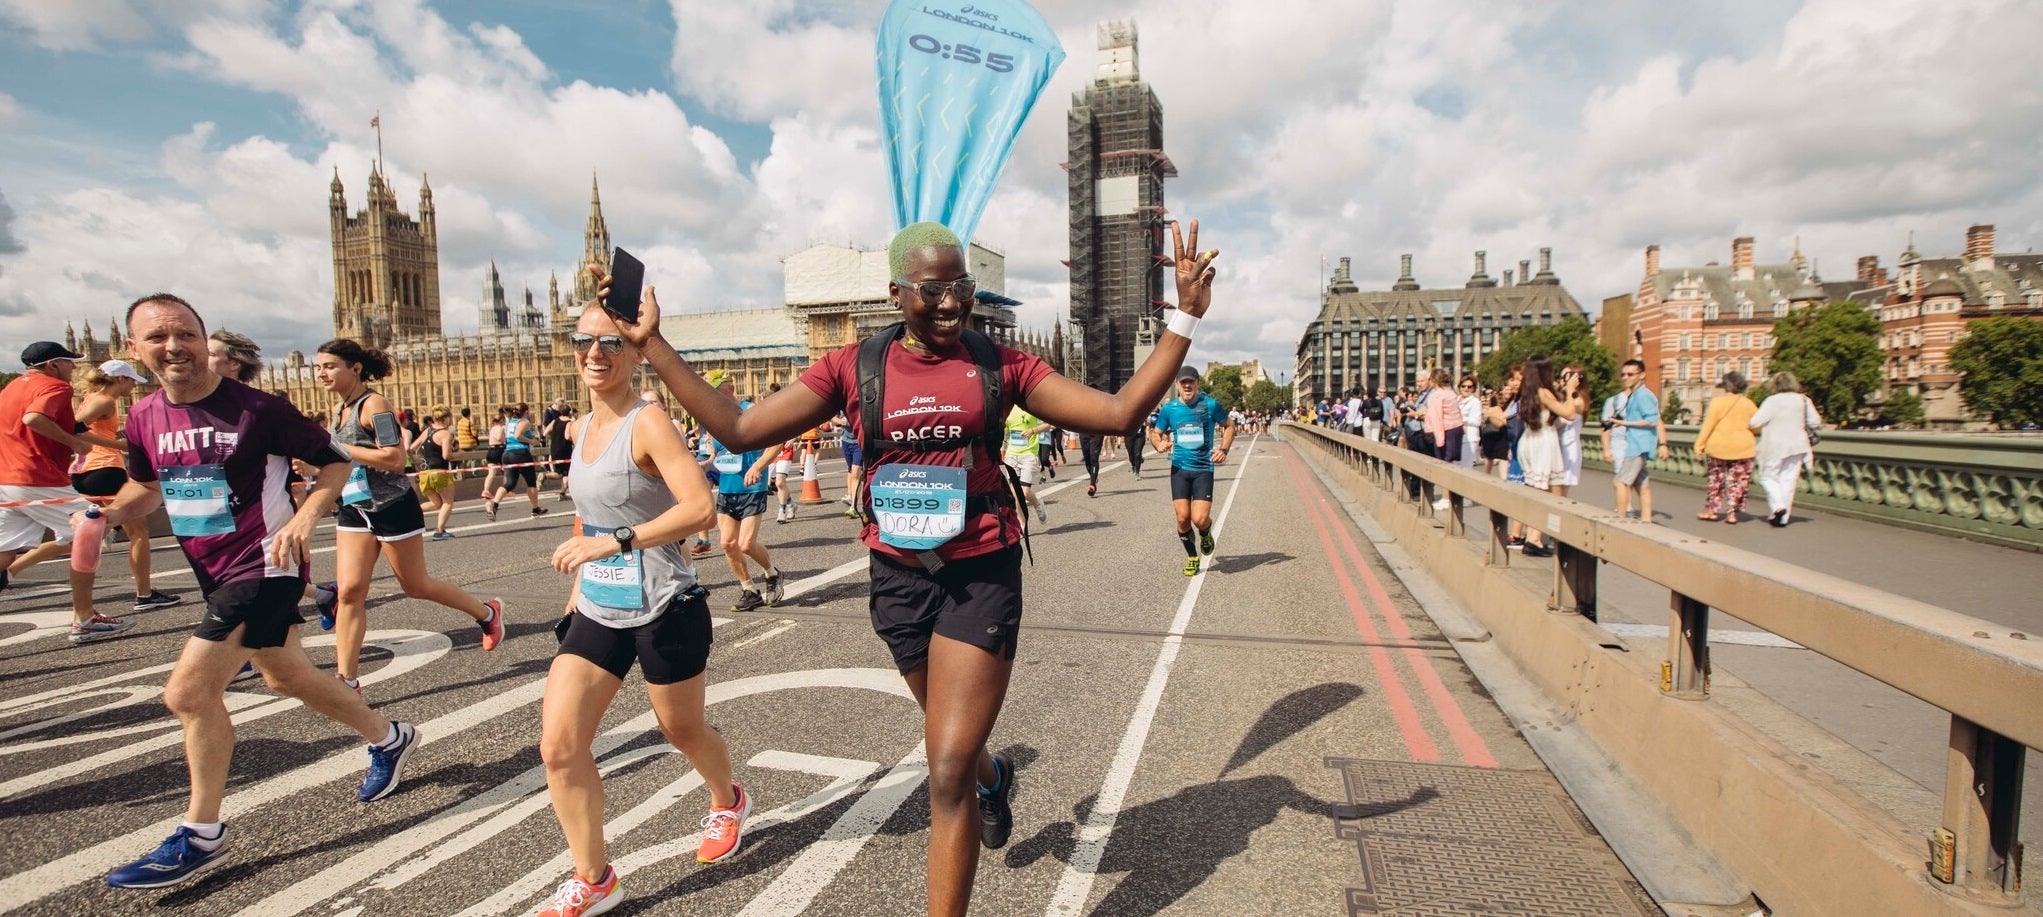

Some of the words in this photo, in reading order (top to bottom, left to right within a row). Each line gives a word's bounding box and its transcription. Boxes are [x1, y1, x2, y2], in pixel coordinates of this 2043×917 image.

[922, 6, 996, 31] LONDON
[1000, 27, 1034, 43] 10K
[909, 34, 1014, 73] 0:55
[887, 406, 937, 418] LONDON
[158, 427, 214, 455] MATT
[891, 425, 962, 442] PACER
[880, 481, 927, 489] LONDON
[874, 498, 940, 510] D1899
[881, 512, 933, 535] DORA
[589, 565, 625, 580] JESSIE
